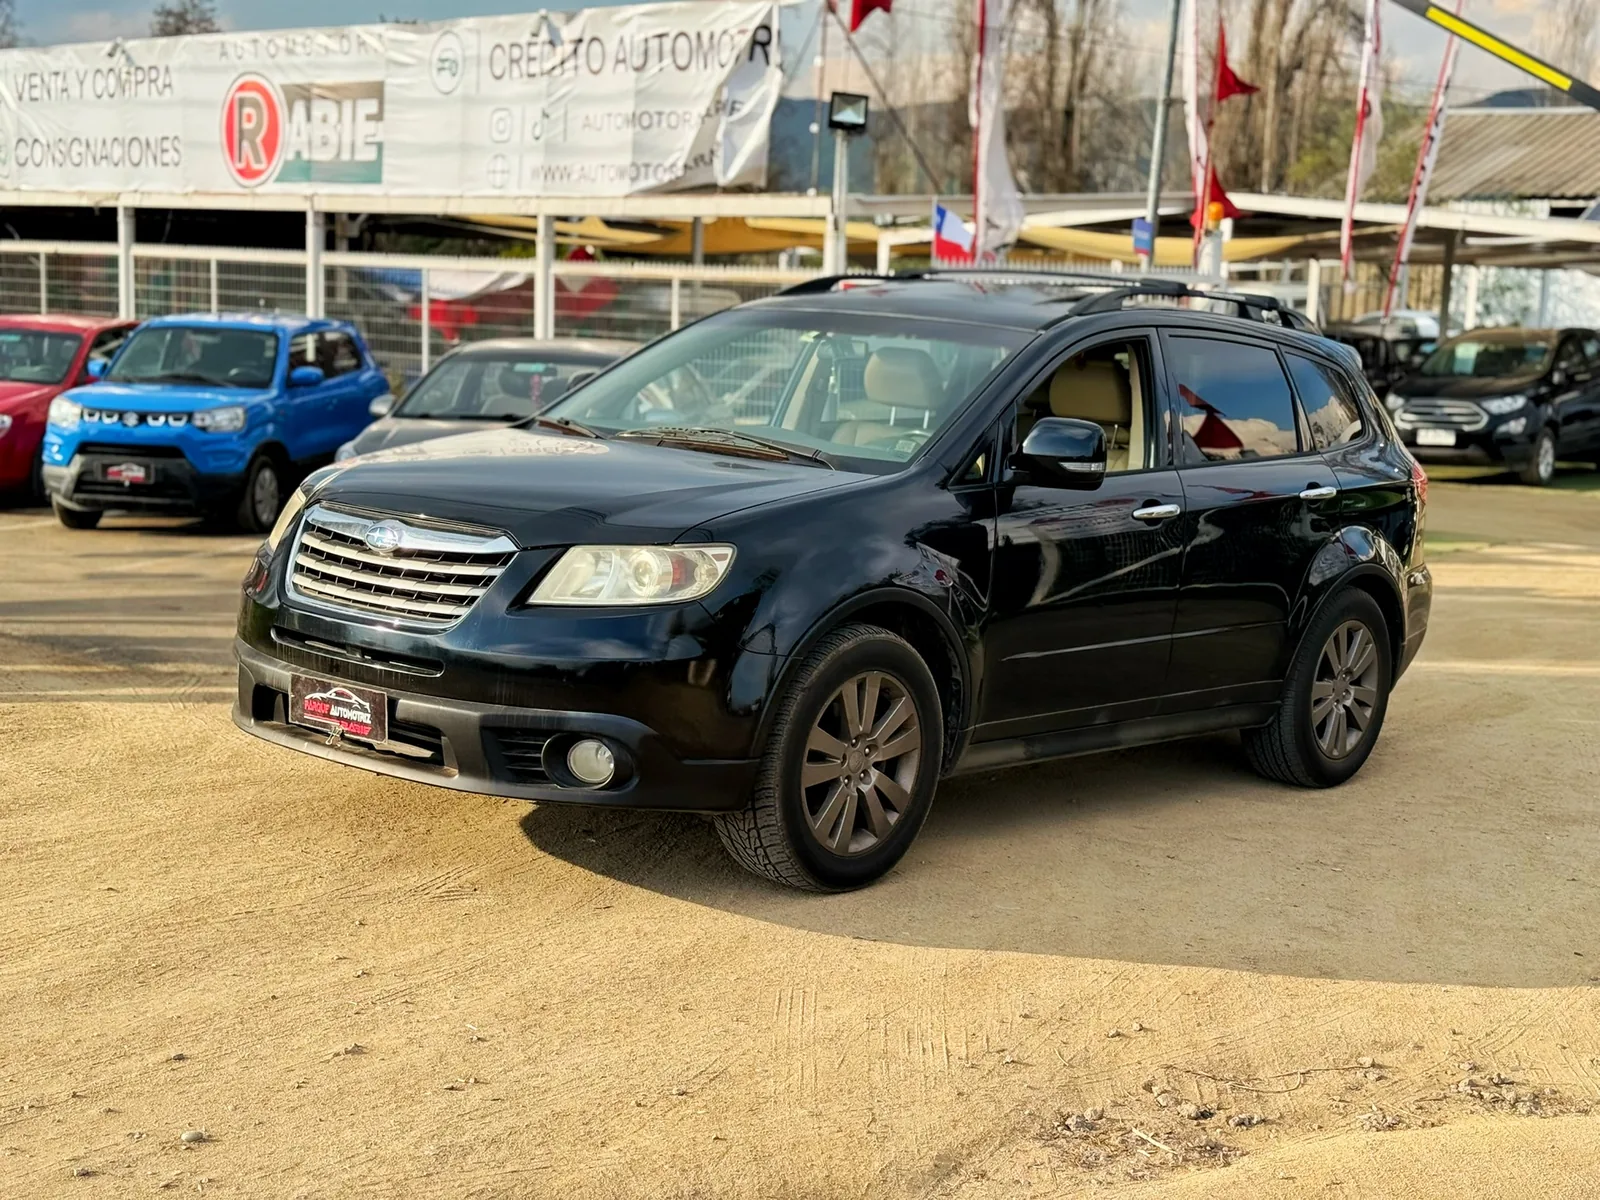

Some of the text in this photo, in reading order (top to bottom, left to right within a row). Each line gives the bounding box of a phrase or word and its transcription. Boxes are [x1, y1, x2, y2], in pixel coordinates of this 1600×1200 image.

[14, 65, 174, 102] VENTA Y COMPRA
[233, 91, 385, 170] RABIE
[14, 135, 182, 168] CONSIGNACIONES
[329, 704, 372, 725] AUTOMOTRIZ
